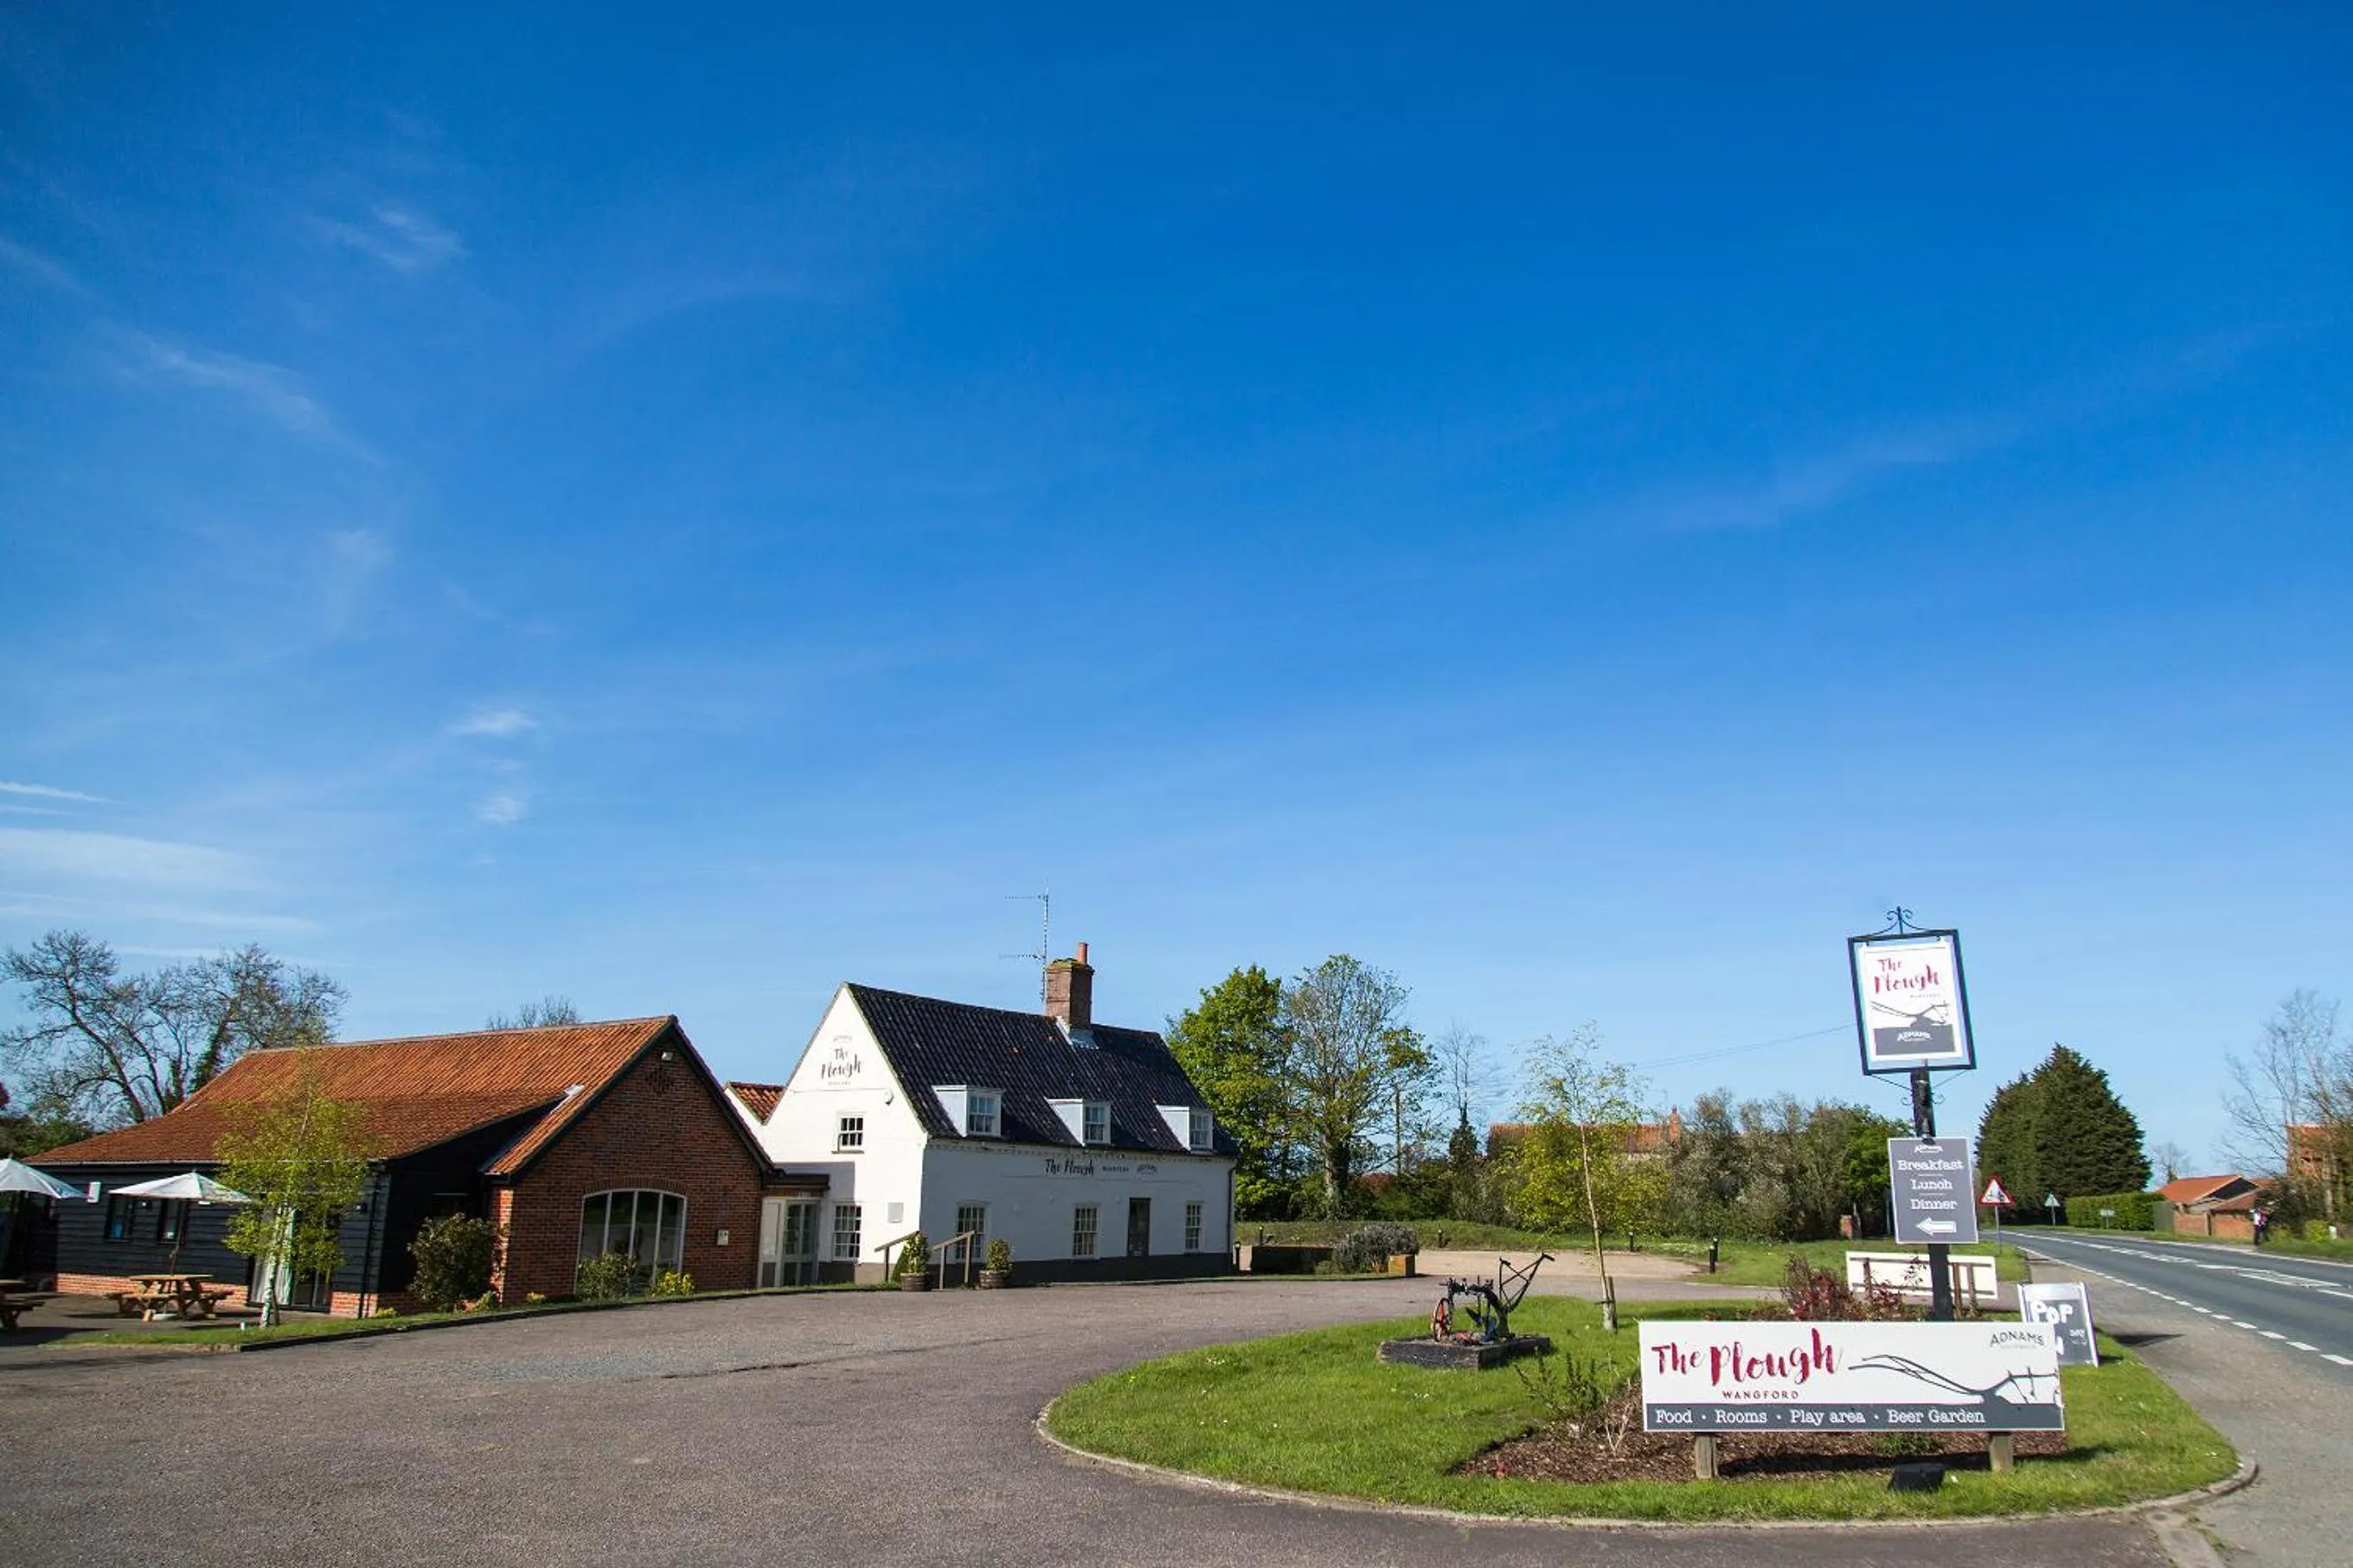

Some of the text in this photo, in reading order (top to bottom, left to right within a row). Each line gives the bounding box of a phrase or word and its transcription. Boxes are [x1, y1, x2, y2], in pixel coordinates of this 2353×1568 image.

[1876, 957, 1902, 972] The
[1896, 1159, 1965, 1171] Breakfast
[1910, 1179, 1953, 1190] Lunch
[1910, 1199, 1958, 1210] Dinner
[1990, 1330, 2045, 1347] ADNAMS
[1651, 1328, 1843, 1387] The Plough
[1722, 1390, 1799, 1399] WANGFORD
[1655, 1408, 1985, 1425] Food Rooms Play area Beer Garden
